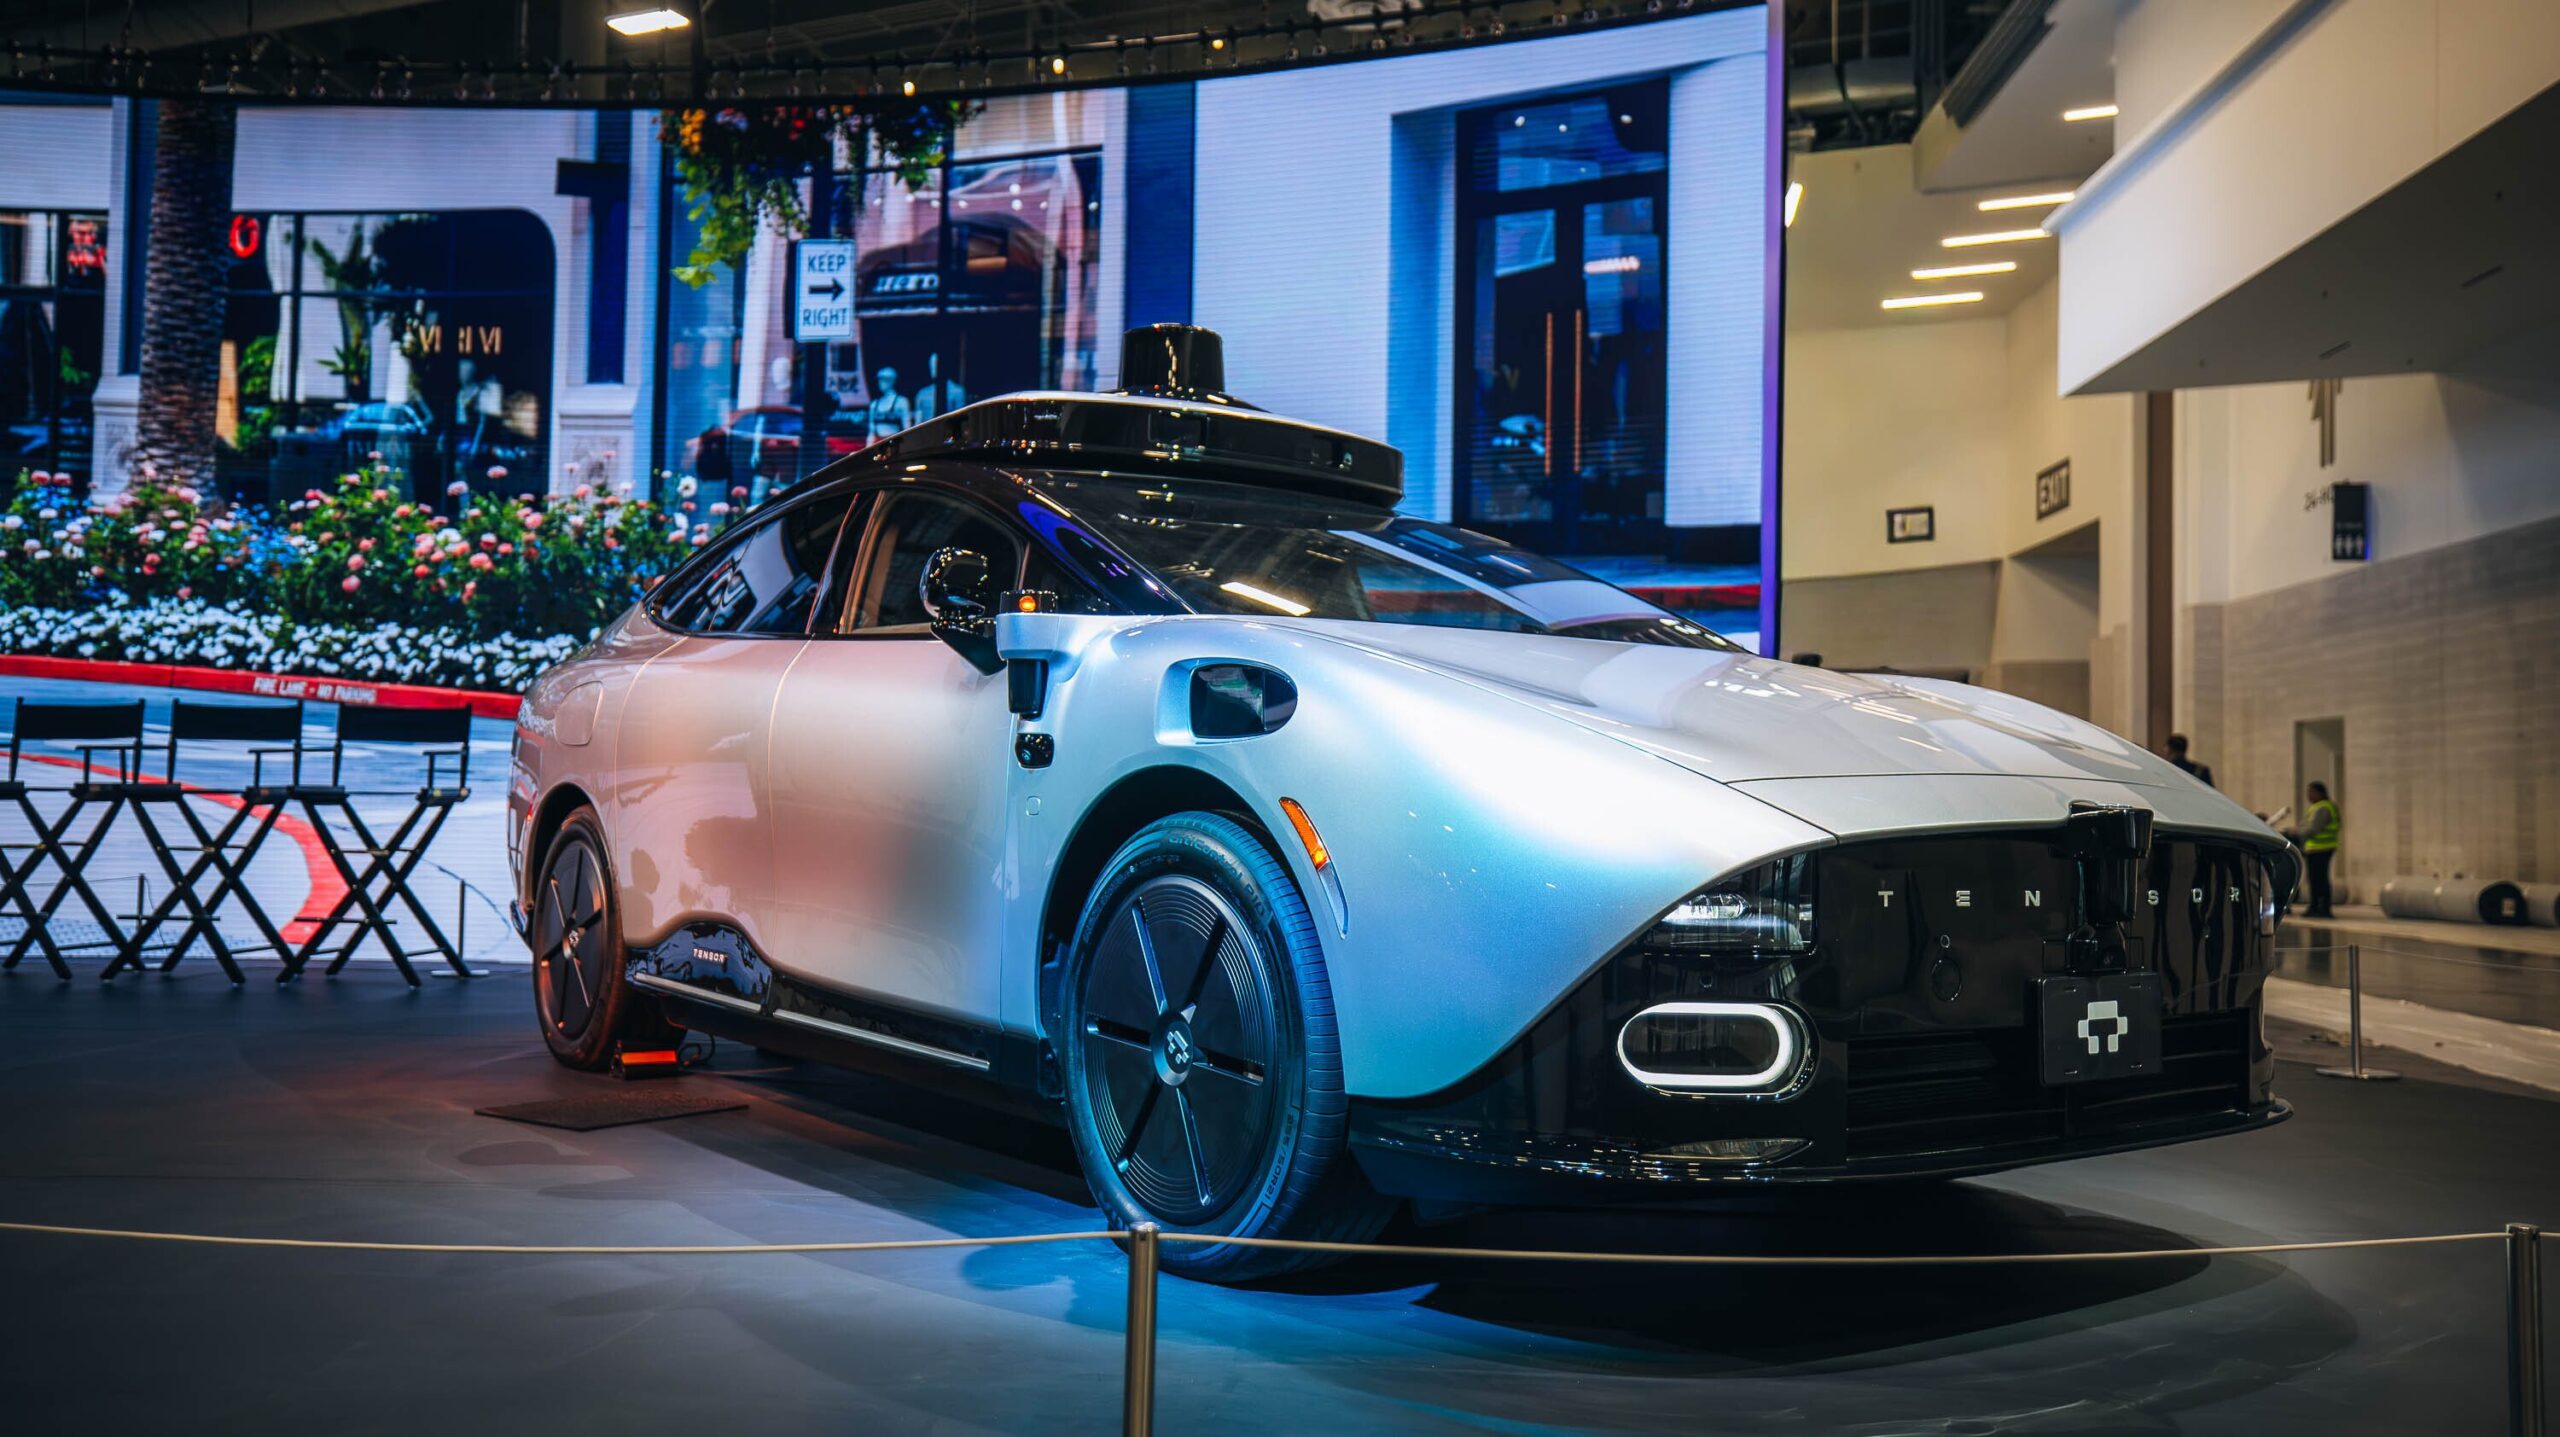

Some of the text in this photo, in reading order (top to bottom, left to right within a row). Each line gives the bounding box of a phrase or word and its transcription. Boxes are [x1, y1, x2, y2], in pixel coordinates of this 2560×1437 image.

[808, 254, 846, 272] KEEP
[803, 307, 847, 327] RIGHT
[2038, 468, 2069, 514] EXIT
[253, 677, 277, 695] FIRE
[279, 679, 307, 698] LANE
[317, 683, 334, 700] NO
[334, 685, 378, 704] PARKING
[693, 948, 725, 964] TENSOR
